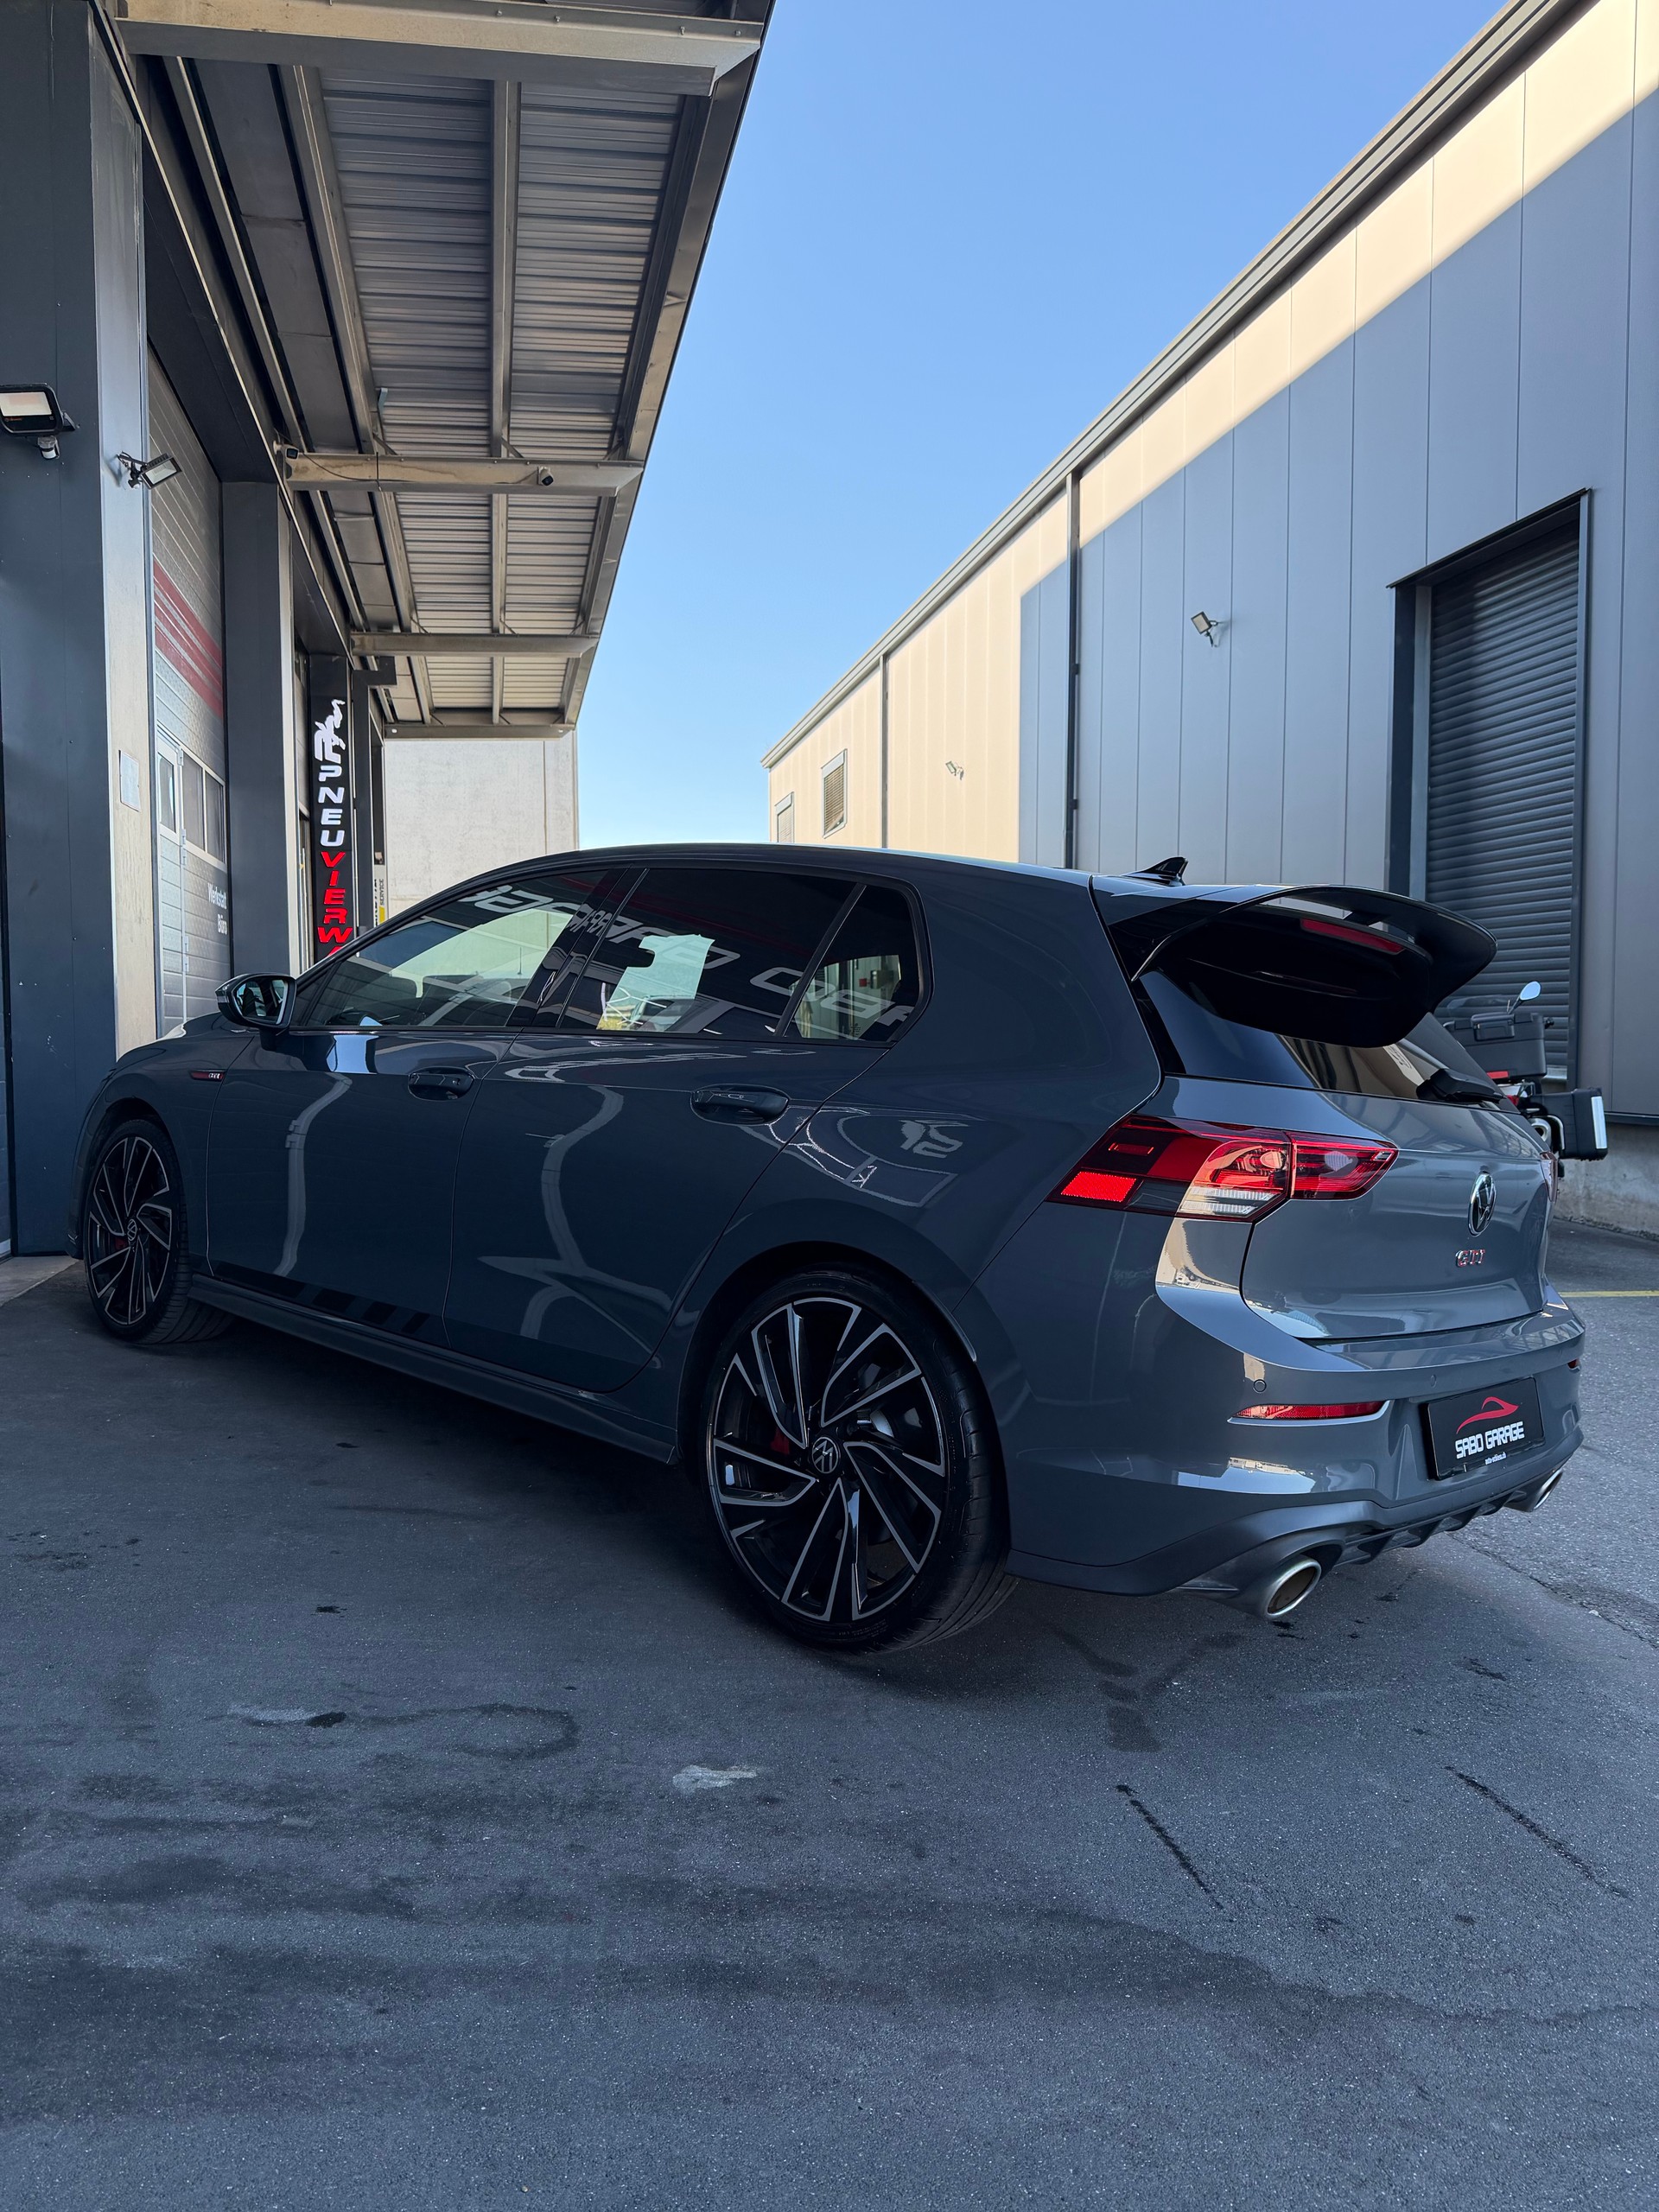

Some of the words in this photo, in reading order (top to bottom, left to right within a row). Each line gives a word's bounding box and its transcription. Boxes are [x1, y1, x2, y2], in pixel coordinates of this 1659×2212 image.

[318, 765, 345, 847] PNEU
[207, 882, 227, 910] Werkstatt
[217, 913, 228, 935] Büro
[1455, 1249, 1485, 1267] GTI
[1455, 1433, 1484, 1459] SABO
[1484, 1421, 1525, 1449] GARAGE
